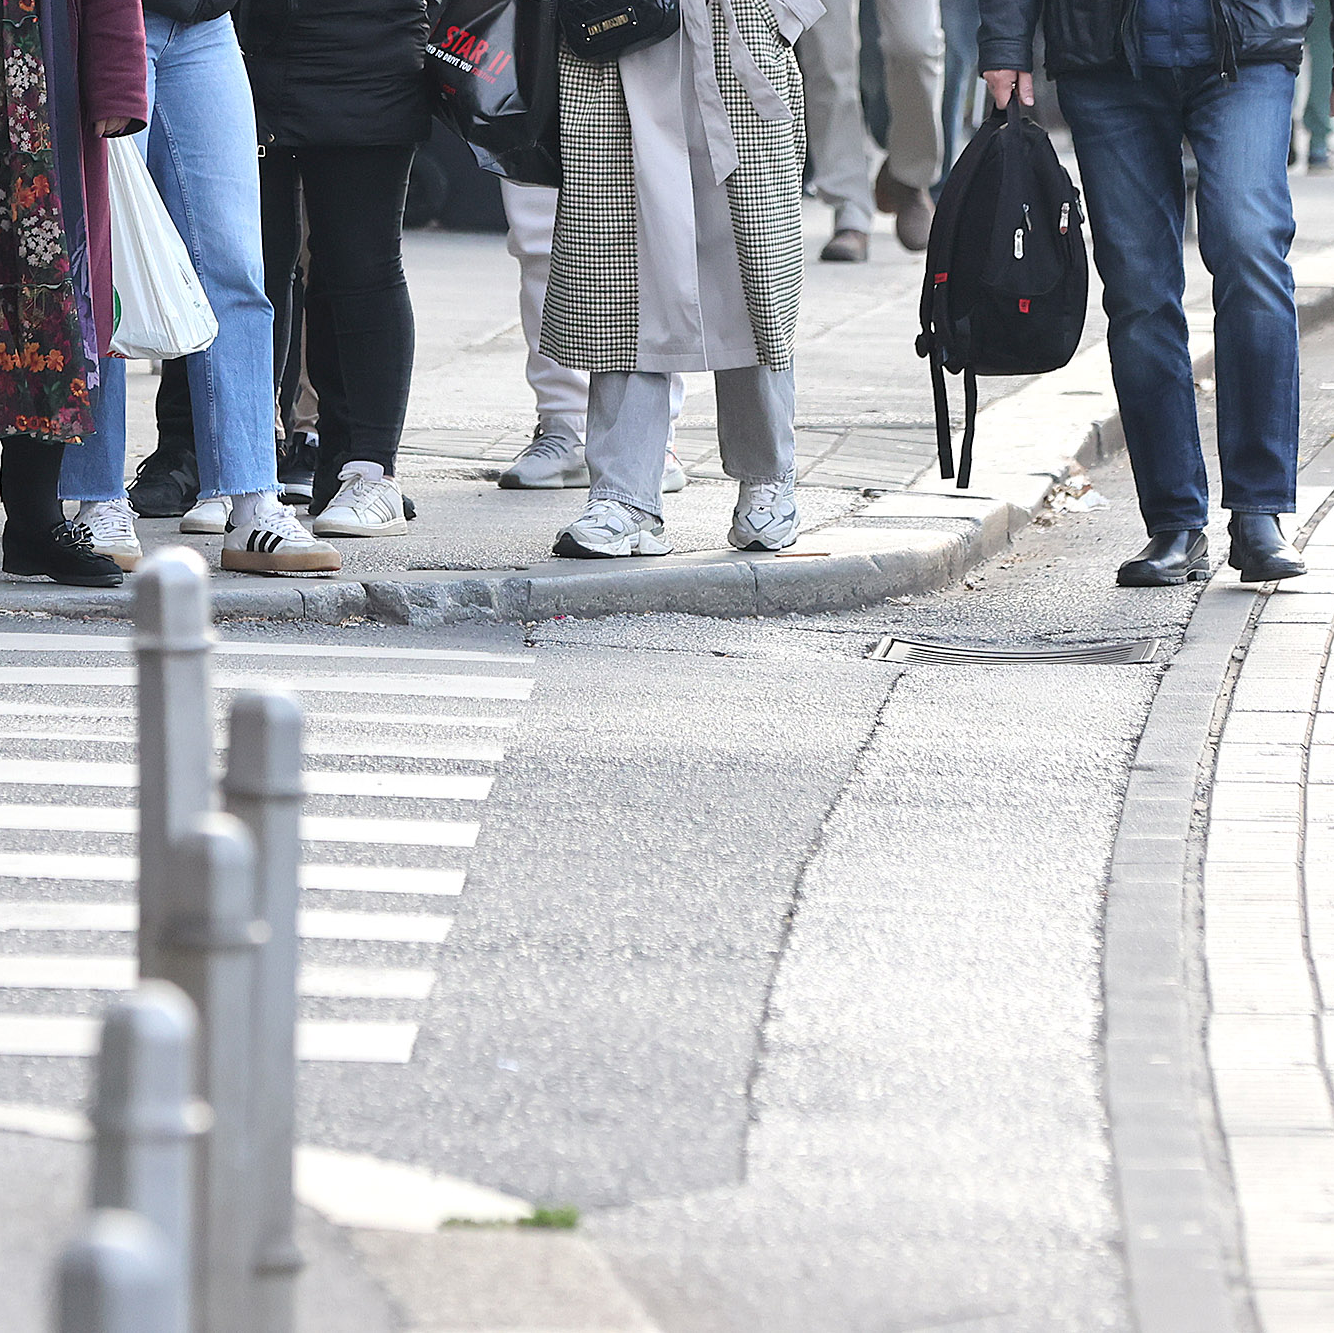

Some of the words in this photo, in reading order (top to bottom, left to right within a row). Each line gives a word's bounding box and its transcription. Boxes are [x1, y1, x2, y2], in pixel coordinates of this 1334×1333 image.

[434, 49, 445, 59] TO
[442, 52, 461, 67] DRIVE
[458, 60, 473, 73] YOU
[440, 25, 490, 65] STAR
